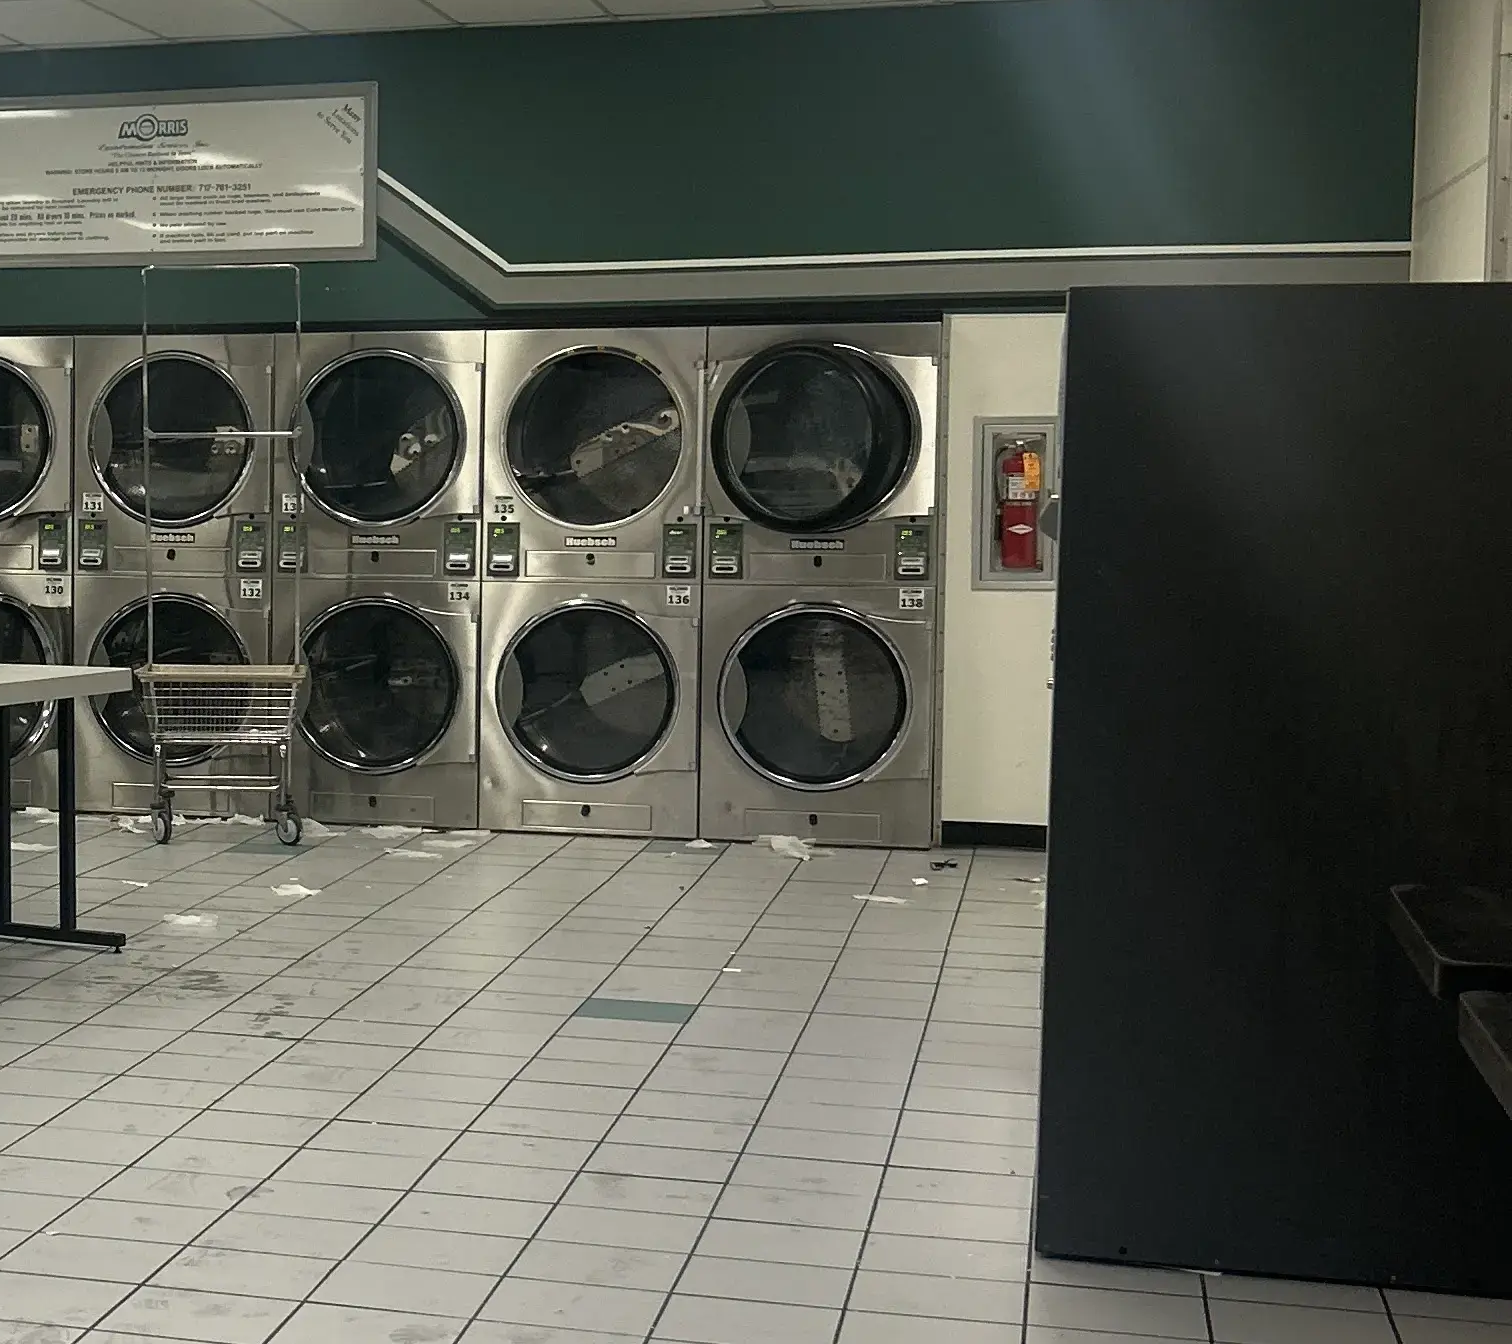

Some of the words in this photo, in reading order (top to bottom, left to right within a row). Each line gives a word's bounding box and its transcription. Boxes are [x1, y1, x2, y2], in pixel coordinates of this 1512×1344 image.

[118, 114, 188, 141] MORRIS
[72, 187, 124, 196] EMERGENCY
[126, 186, 154, 194] PHONE
[84, 502, 102, 510] 131
[284, 503, 301, 512] 13
[494, 504, 514, 513] 135
[565, 537, 616, 546] Huebsch
[791, 540, 844, 549] Huebsch
[45, 586, 64, 594] 130
[242, 588, 260, 596] 132
[450, 592, 470, 600] 134
[668, 595, 690, 604] 136
[901, 598, 924, 608] 138
